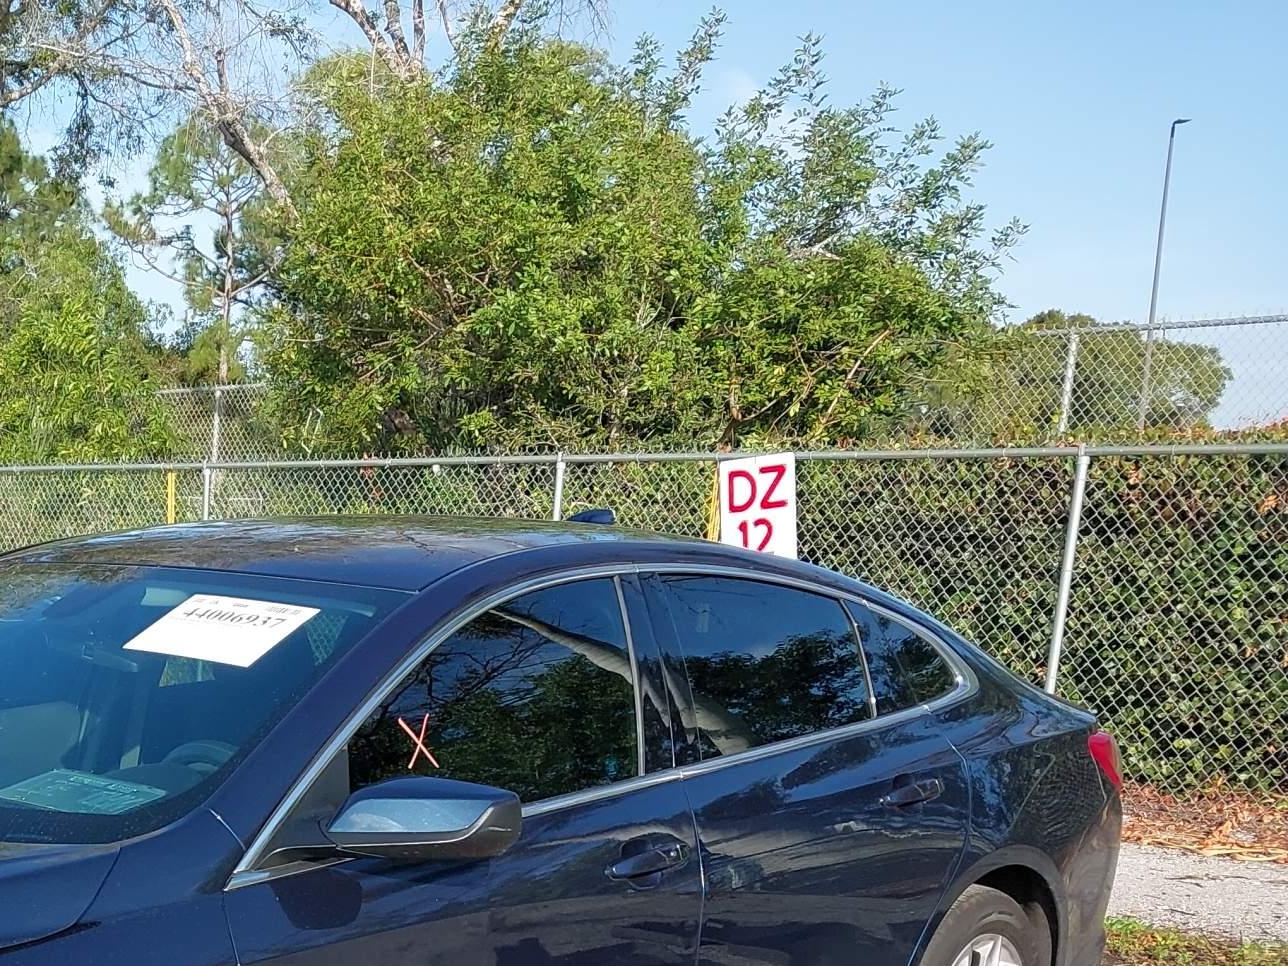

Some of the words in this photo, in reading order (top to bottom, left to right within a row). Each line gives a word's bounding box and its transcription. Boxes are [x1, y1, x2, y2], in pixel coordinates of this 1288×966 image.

[728, 464, 788, 513] DZ
[738, 518, 773, 552] 12
[184, 606, 287, 629] 44006937
